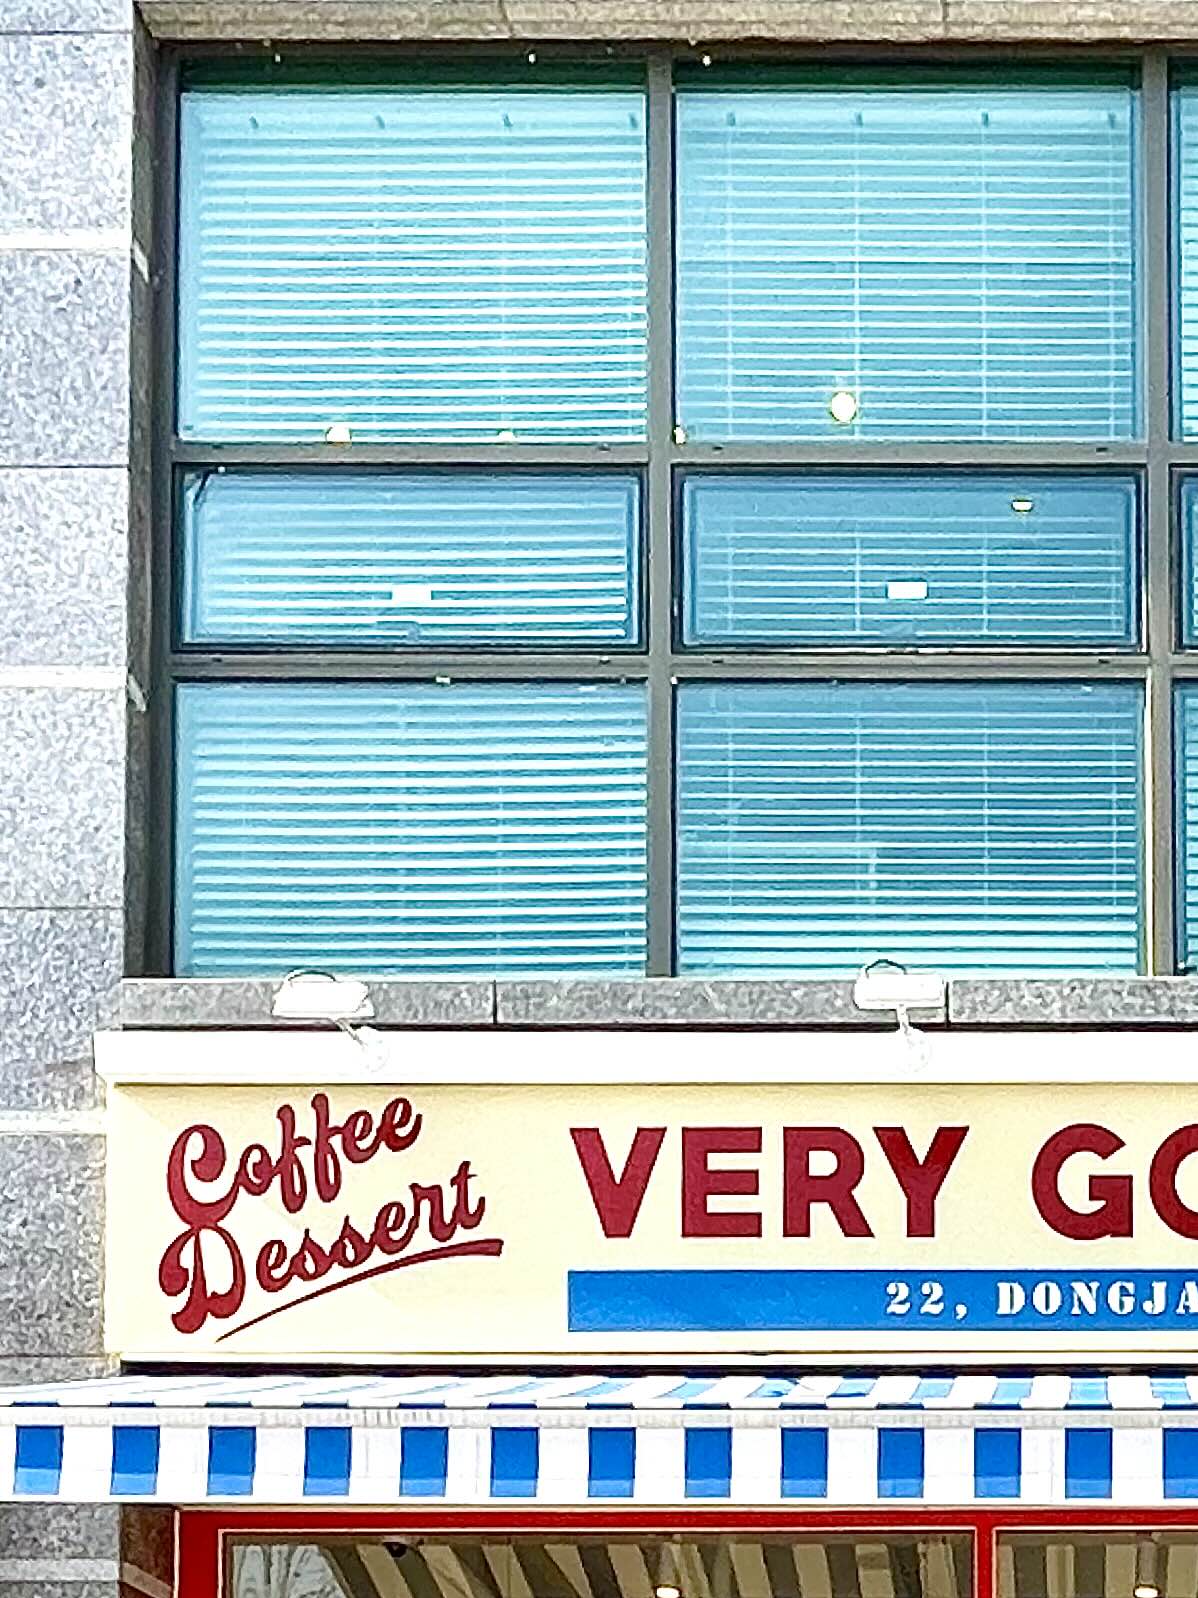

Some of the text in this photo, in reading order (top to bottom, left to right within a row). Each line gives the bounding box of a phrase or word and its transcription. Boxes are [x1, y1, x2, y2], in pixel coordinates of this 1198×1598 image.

[166, 1092, 423, 1228] Coffee
[569, 1125, 968, 1239] VERY
[158, 1160, 486, 1334] Dessert
[886, 1281, 968, 1320] 22,
